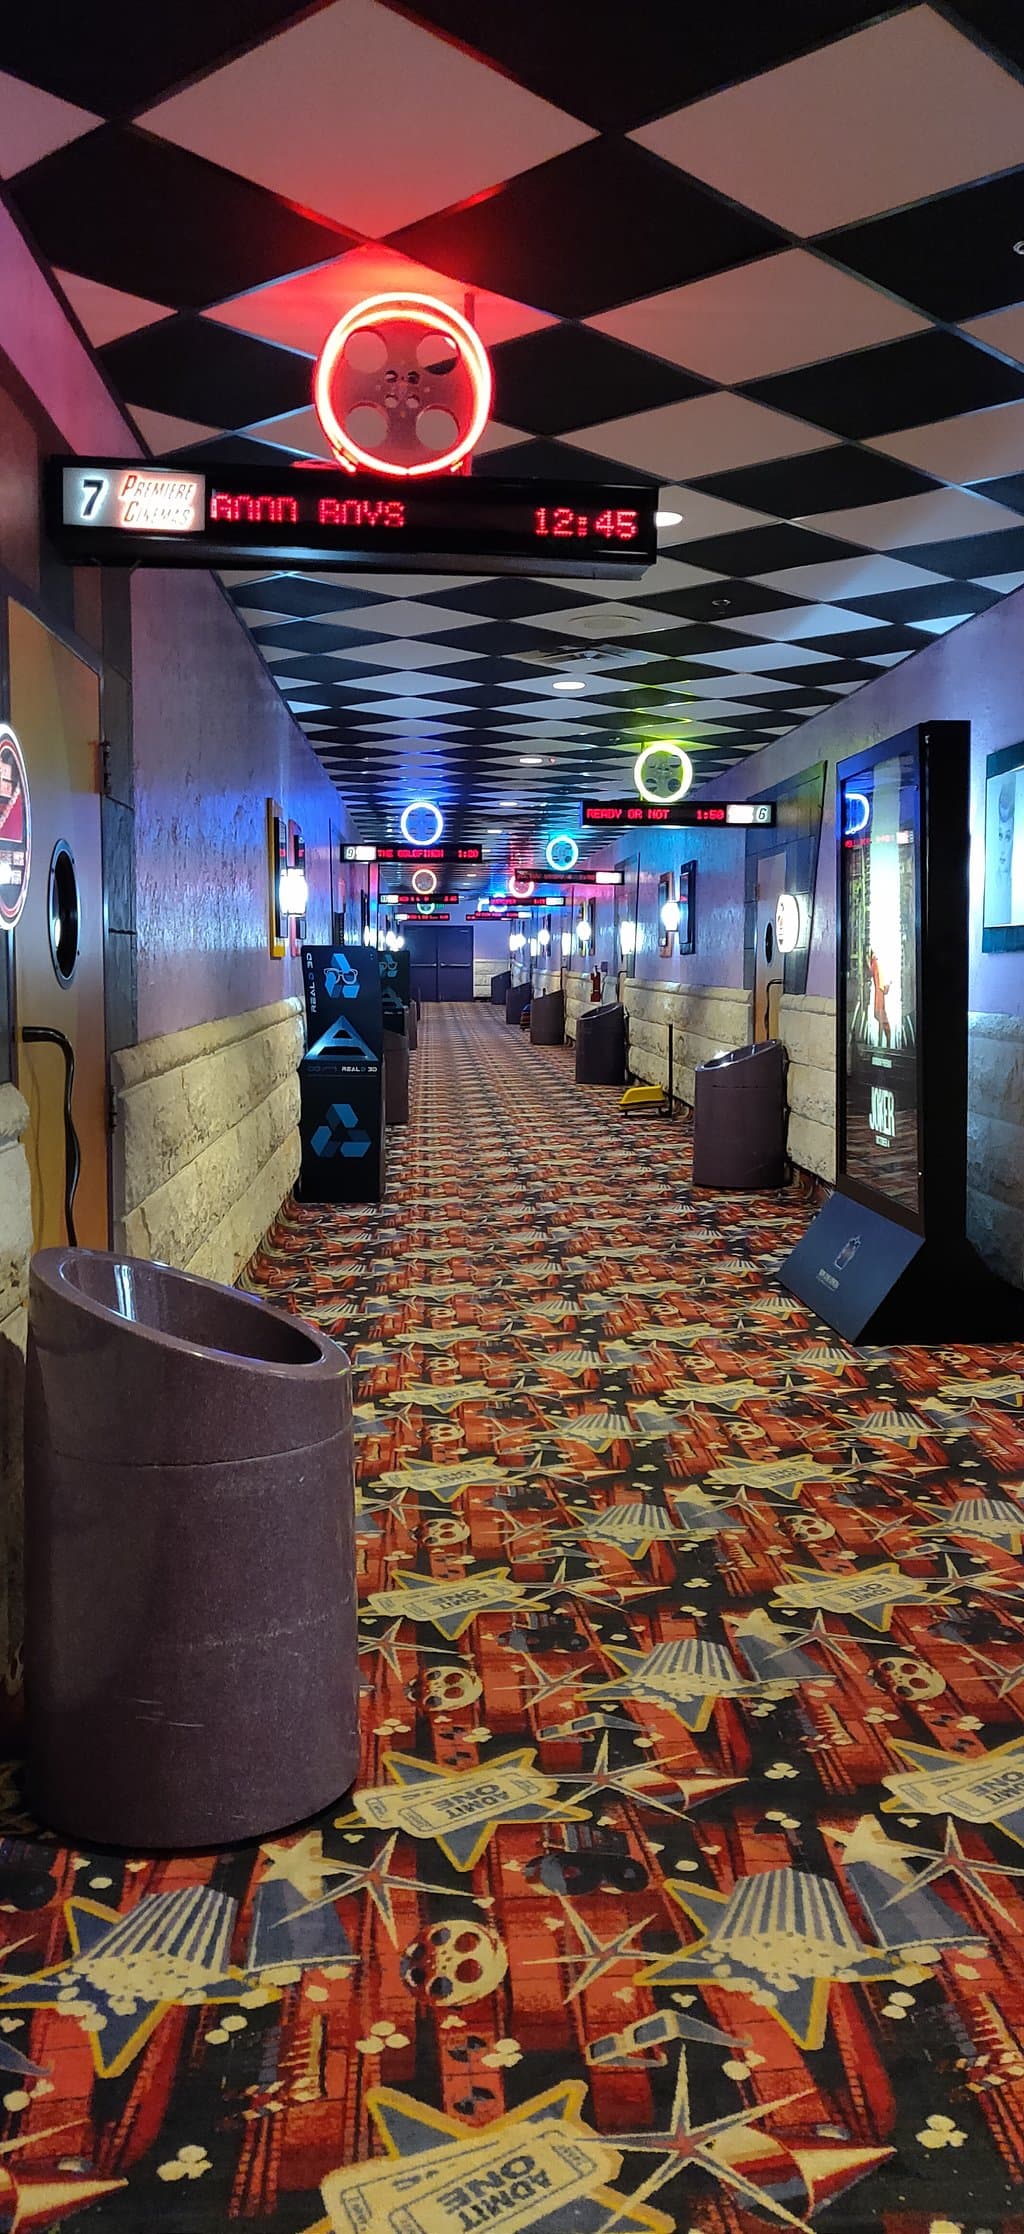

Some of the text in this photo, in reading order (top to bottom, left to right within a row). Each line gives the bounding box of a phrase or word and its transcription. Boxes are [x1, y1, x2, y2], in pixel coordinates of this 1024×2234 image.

[82, 479, 104, 516] 7
[535, 508, 638, 539] 12:45
[586, 808, 670, 819] READY OR NOT
[758, 807, 766, 820] 6
[869, 1086, 896, 1137] JOKER
[431, 1784, 500, 1811] ONE
[446, 1790, 510, 1819] ADMIT
[436, 2155, 535, 2215] ONE
[463, 2168, 552, 2234] ADMIT
